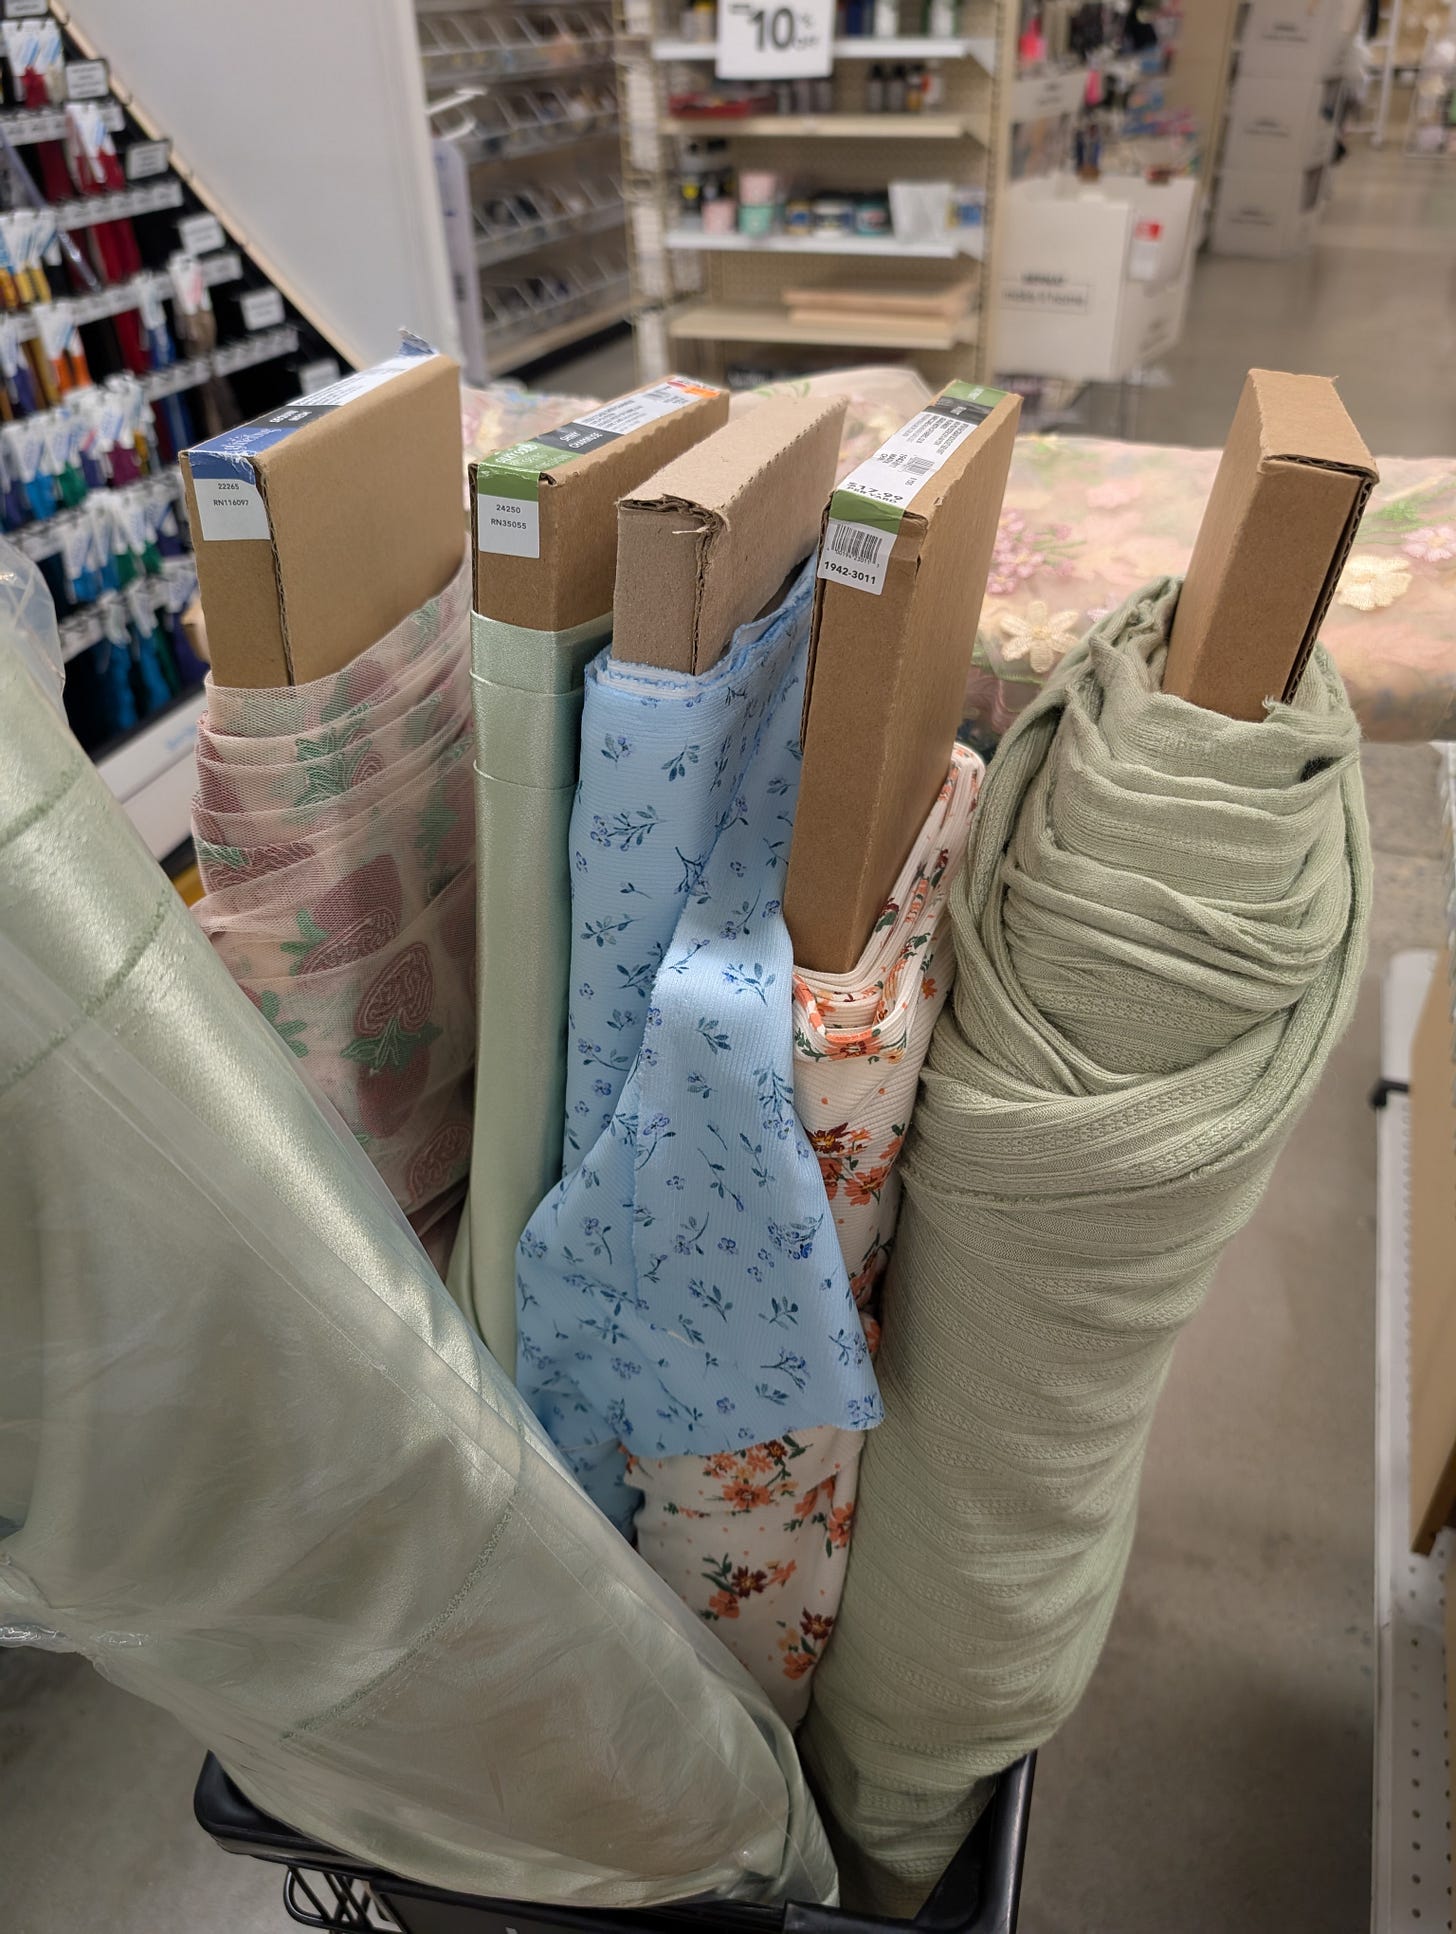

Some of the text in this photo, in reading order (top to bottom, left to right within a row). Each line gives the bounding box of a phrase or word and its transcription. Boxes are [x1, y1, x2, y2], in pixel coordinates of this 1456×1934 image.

[750, 7, 796, 51] 10
[217, 482, 240, 490] 22265
[496, 504, 521, 514] 24250
[490, 518, 527, 530] RN35055
[824, 561, 876, 585] 1942-3011
